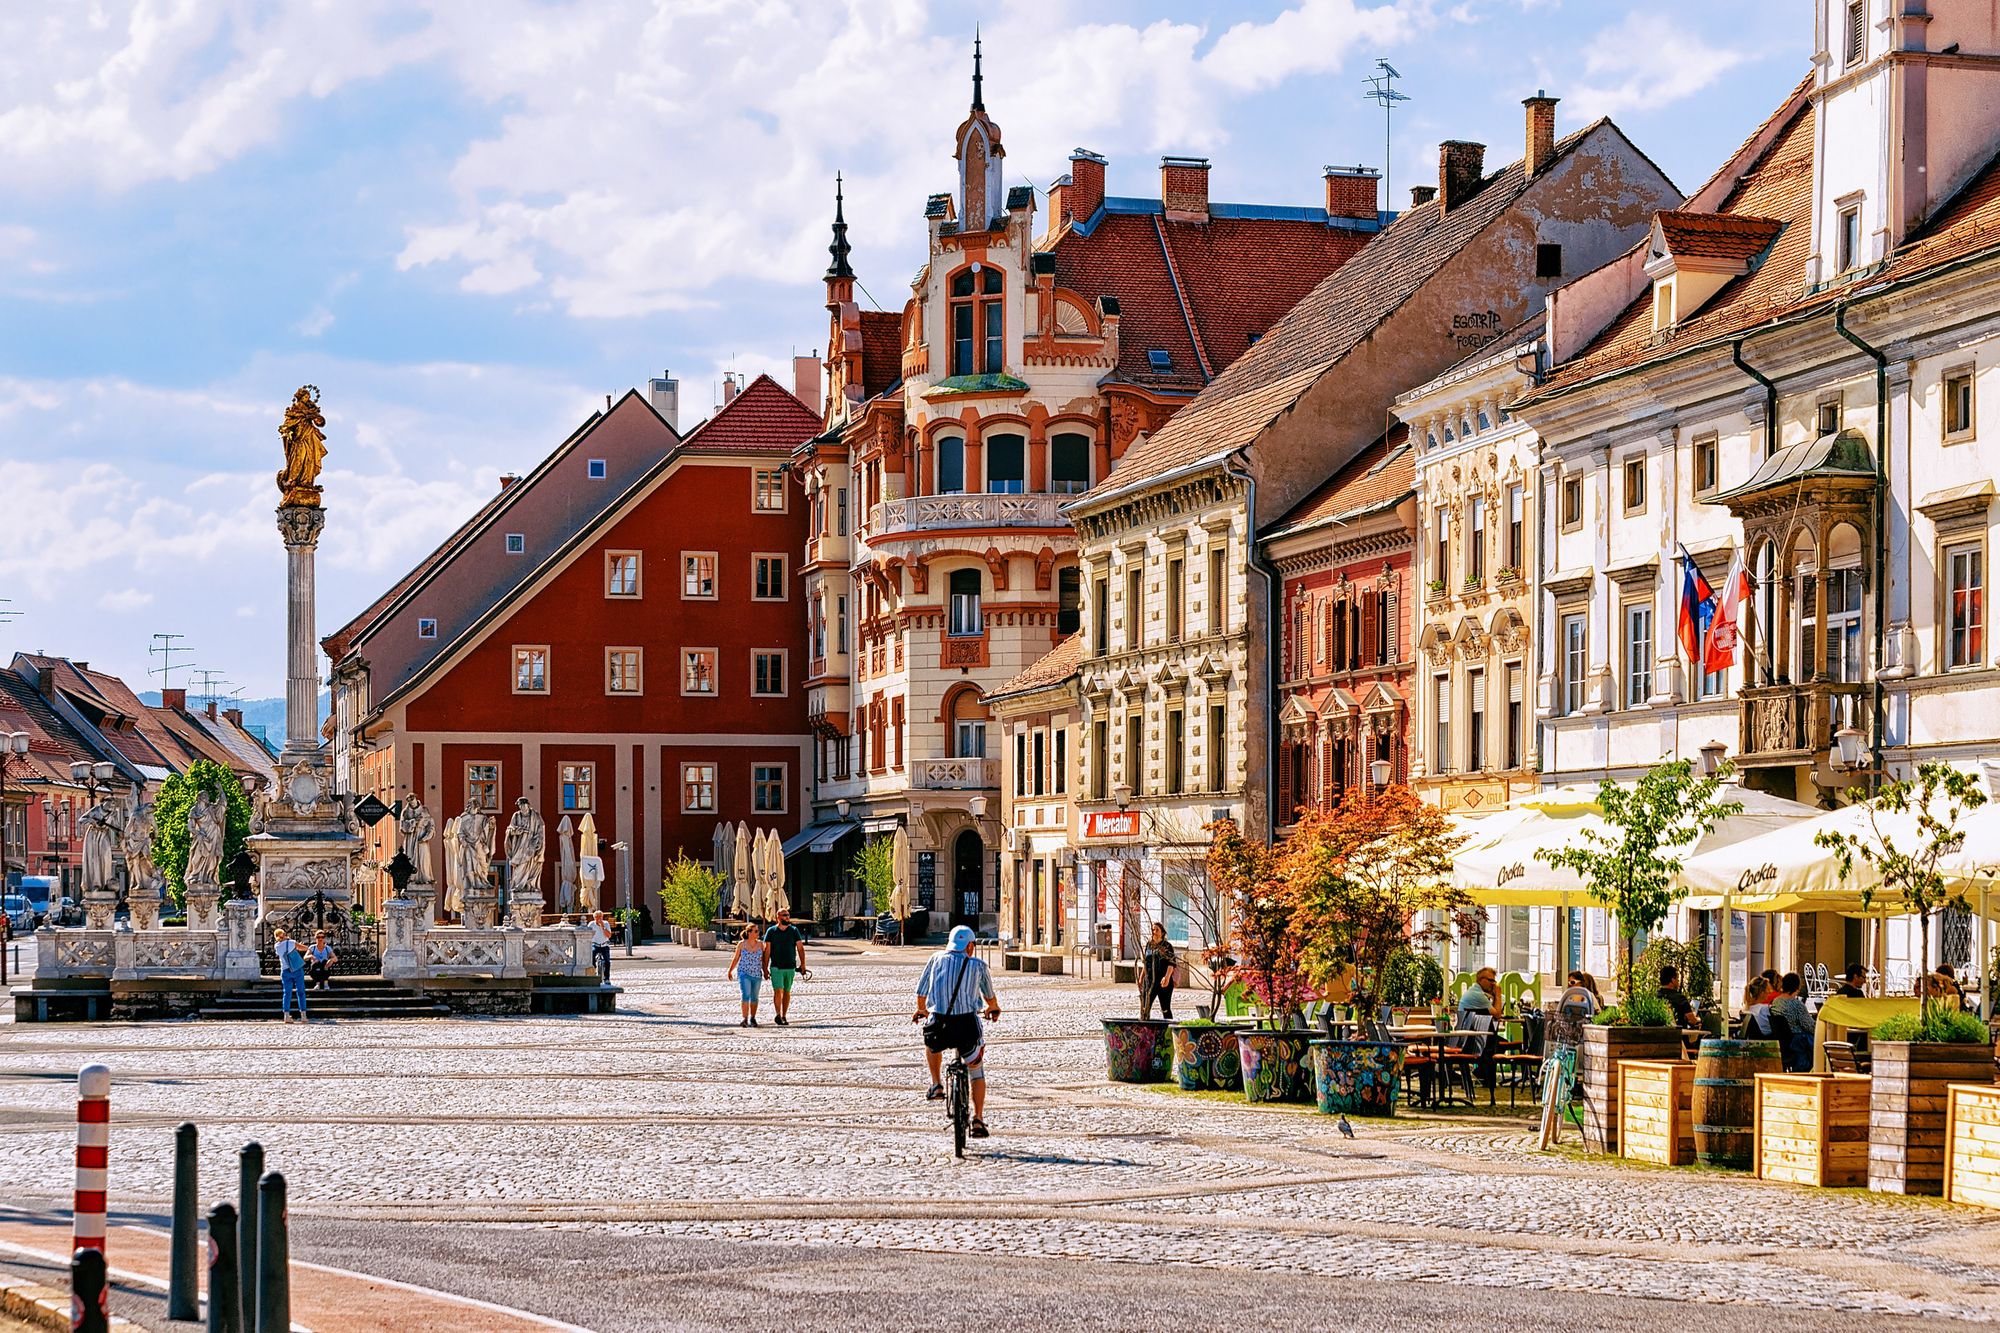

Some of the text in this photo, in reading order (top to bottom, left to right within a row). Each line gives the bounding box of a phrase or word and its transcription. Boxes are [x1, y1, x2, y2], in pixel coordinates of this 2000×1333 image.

[1095, 814, 1132, 834] Mercator
[1497, 861, 1525, 887] Cockta
[1737, 862, 1778, 892] Cockta
